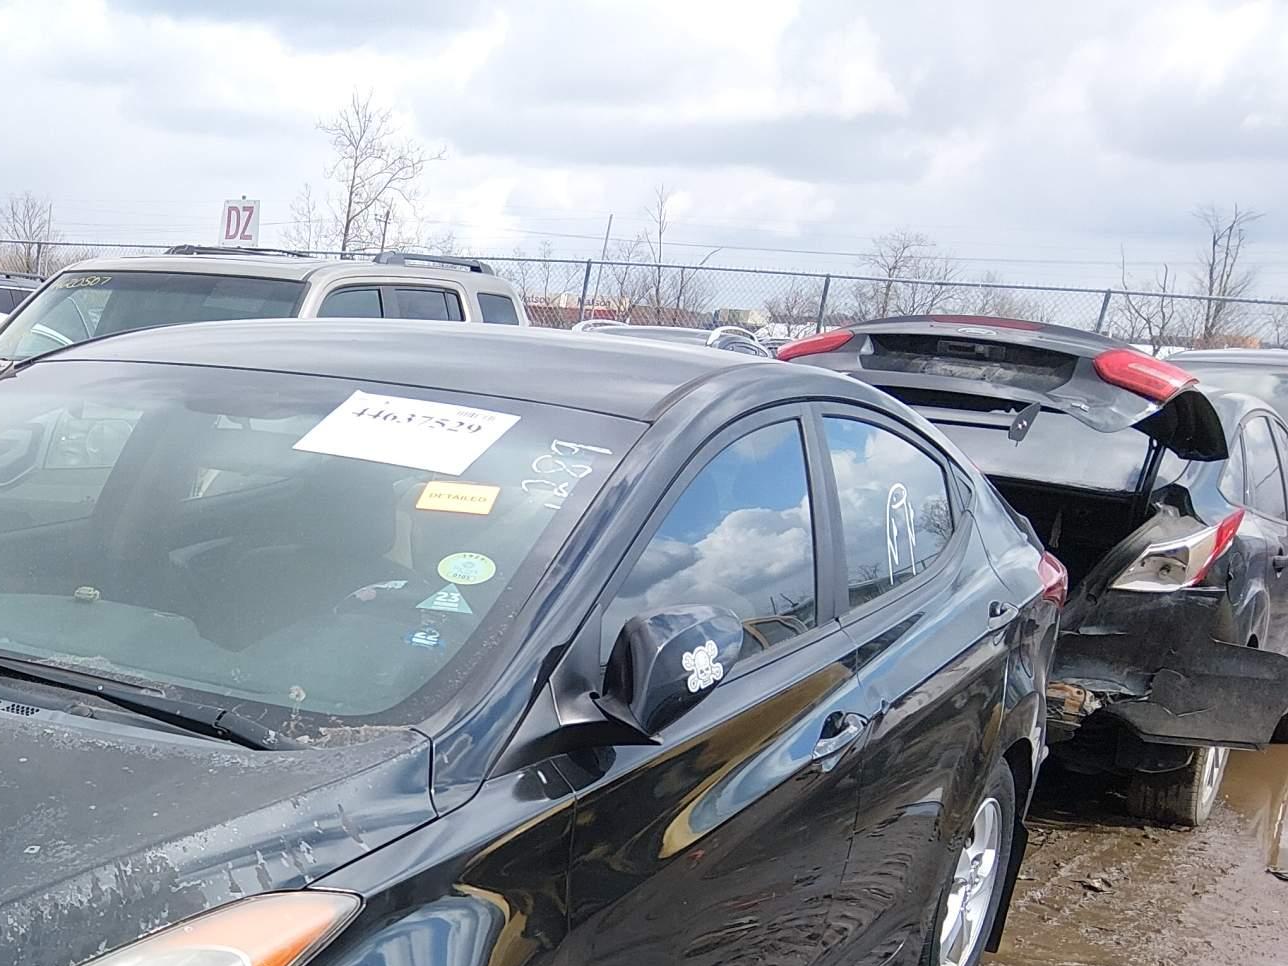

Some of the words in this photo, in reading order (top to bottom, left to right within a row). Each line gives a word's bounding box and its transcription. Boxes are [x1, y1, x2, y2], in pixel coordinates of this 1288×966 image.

[224, 205, 255, 241] DZ
[352, 407, 483, 434] 44637529
[428, 491, 488, 503] DETAILED
